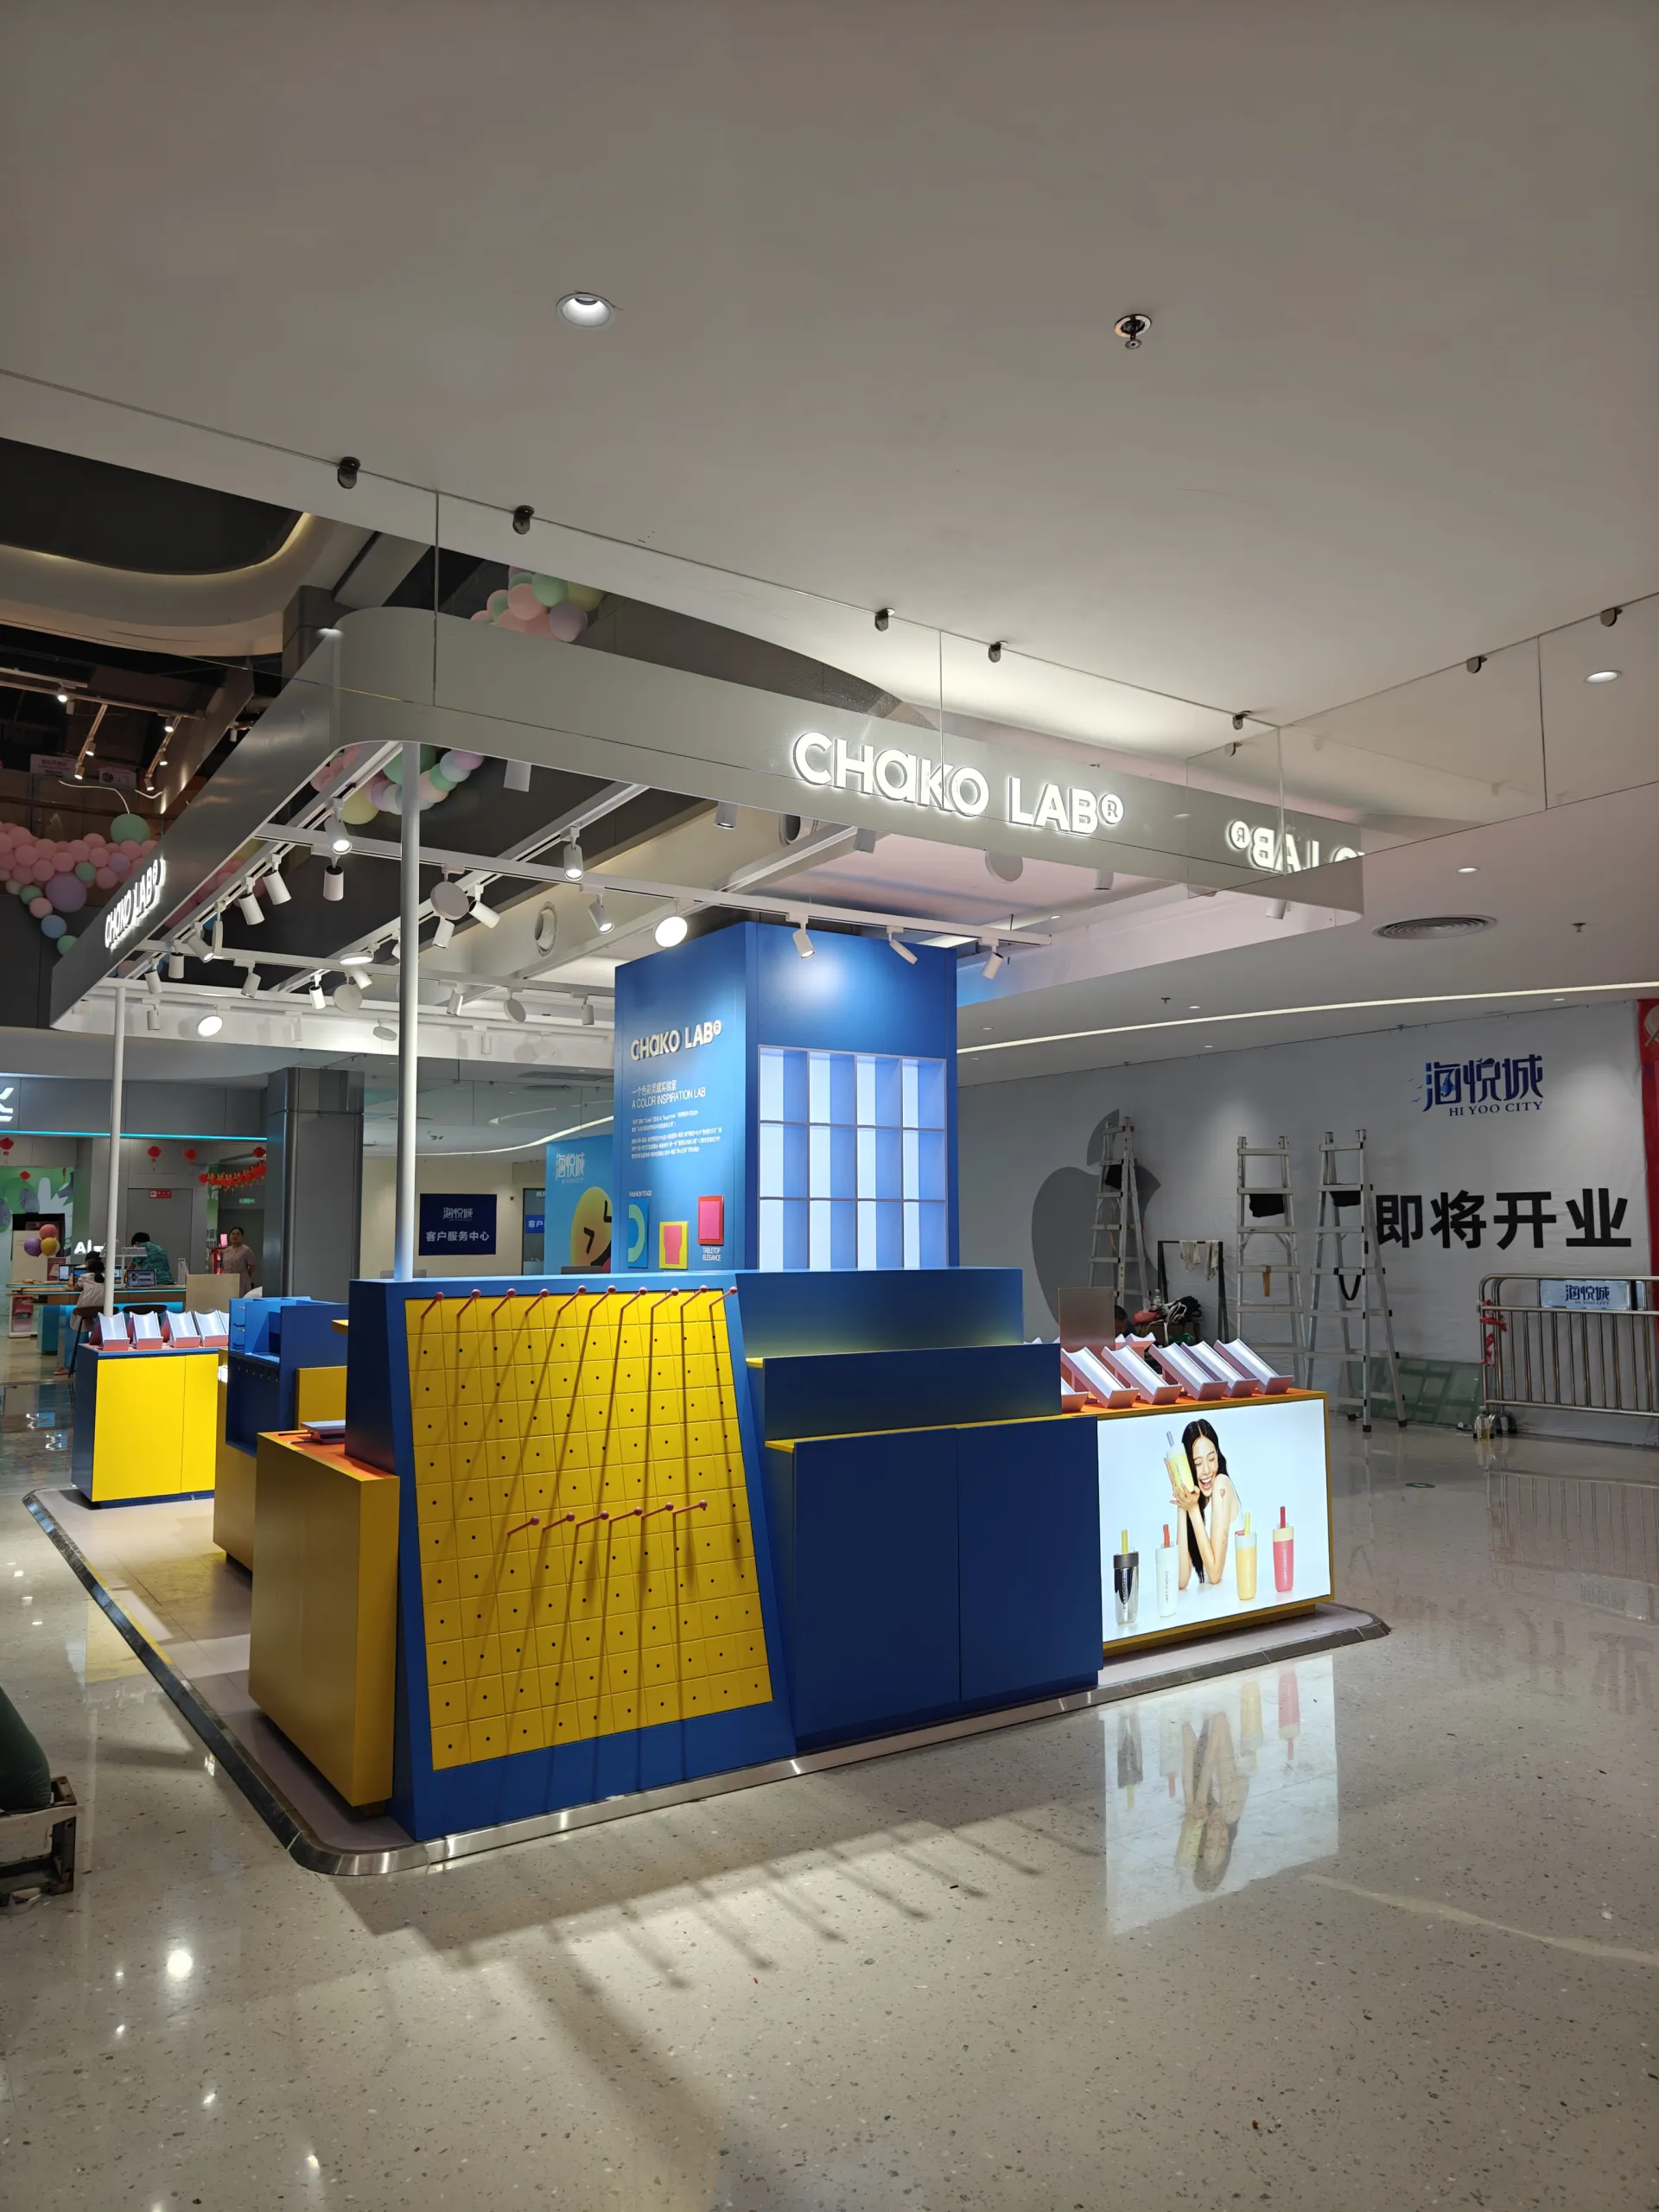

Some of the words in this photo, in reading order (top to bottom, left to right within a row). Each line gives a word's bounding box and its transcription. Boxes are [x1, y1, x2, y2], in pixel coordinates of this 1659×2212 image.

[1422, 1053, 1544, 1112] 海悦城
[632, 1099, 637, 1109] A
[637, 1096, 657, 1109] COLOR
[657, 1088, 693, 1105] INSPIRATION
[694, 1086, 706, 1098] LAB
[1449, 1107, 1464, 1116] HI
[1469, 1103, 1500, 1116] YOO
[1505, 1101, 1543, 1112] CITY
[1376, 1188, 1632, 1250] 即将开业
[426, 1231, 490, 1242] 客户服务中心
[1565, 1284, 1610, 1301] 海悦城
